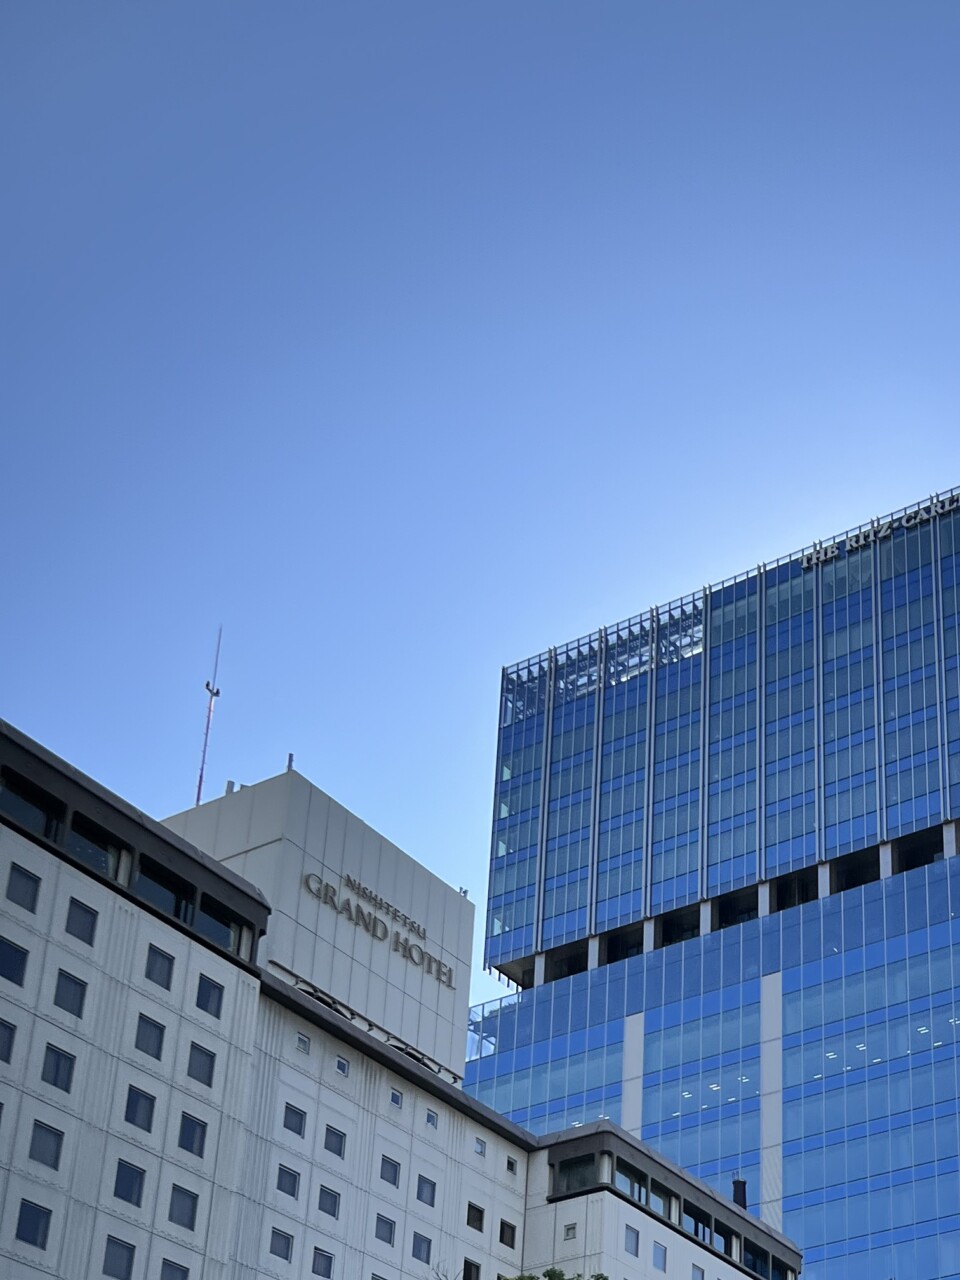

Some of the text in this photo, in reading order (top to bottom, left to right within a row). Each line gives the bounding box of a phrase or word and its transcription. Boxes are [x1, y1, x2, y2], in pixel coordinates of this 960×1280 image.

[800, 543, 839, 570] THE
[304, 873, 457, 991] GRAND HOTEL
[344, 873, 427, 941] NISHITETSU
